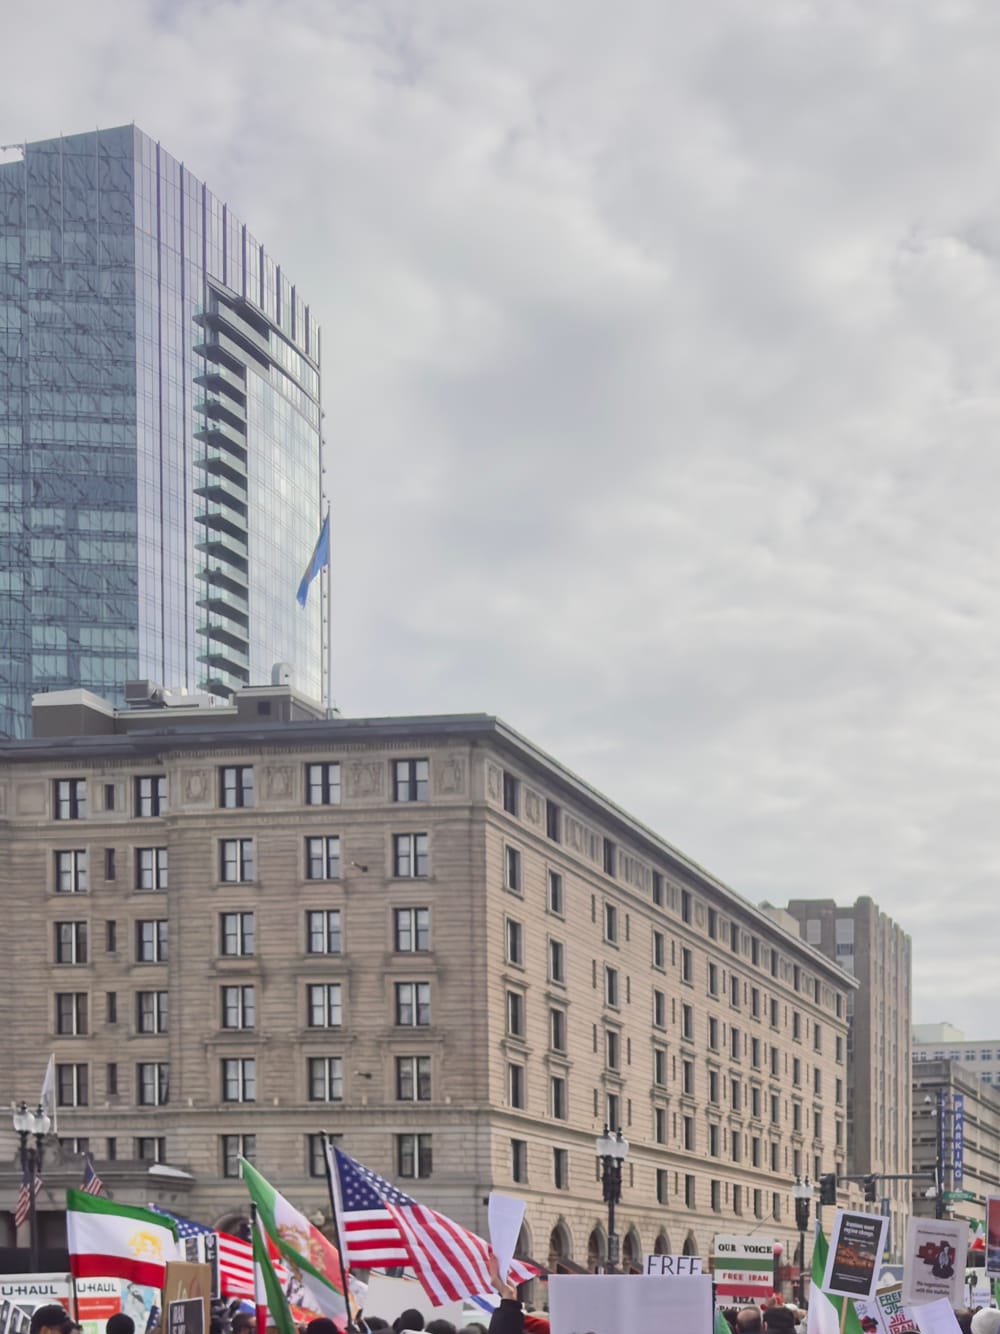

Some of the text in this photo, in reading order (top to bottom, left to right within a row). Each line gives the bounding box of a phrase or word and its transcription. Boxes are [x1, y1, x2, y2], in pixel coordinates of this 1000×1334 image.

[954, 1113, 962, 1178] PARKING
[718, 1243, 773, 1254] OUR VOICE
[647, 1255, 702, 1275] FREE
[722, 1272, 769, 1282] FREE IRAN
[1, 1285, 58, 1296] U-HAUL
[77, 1283, 117, 1293] U-HAUL
